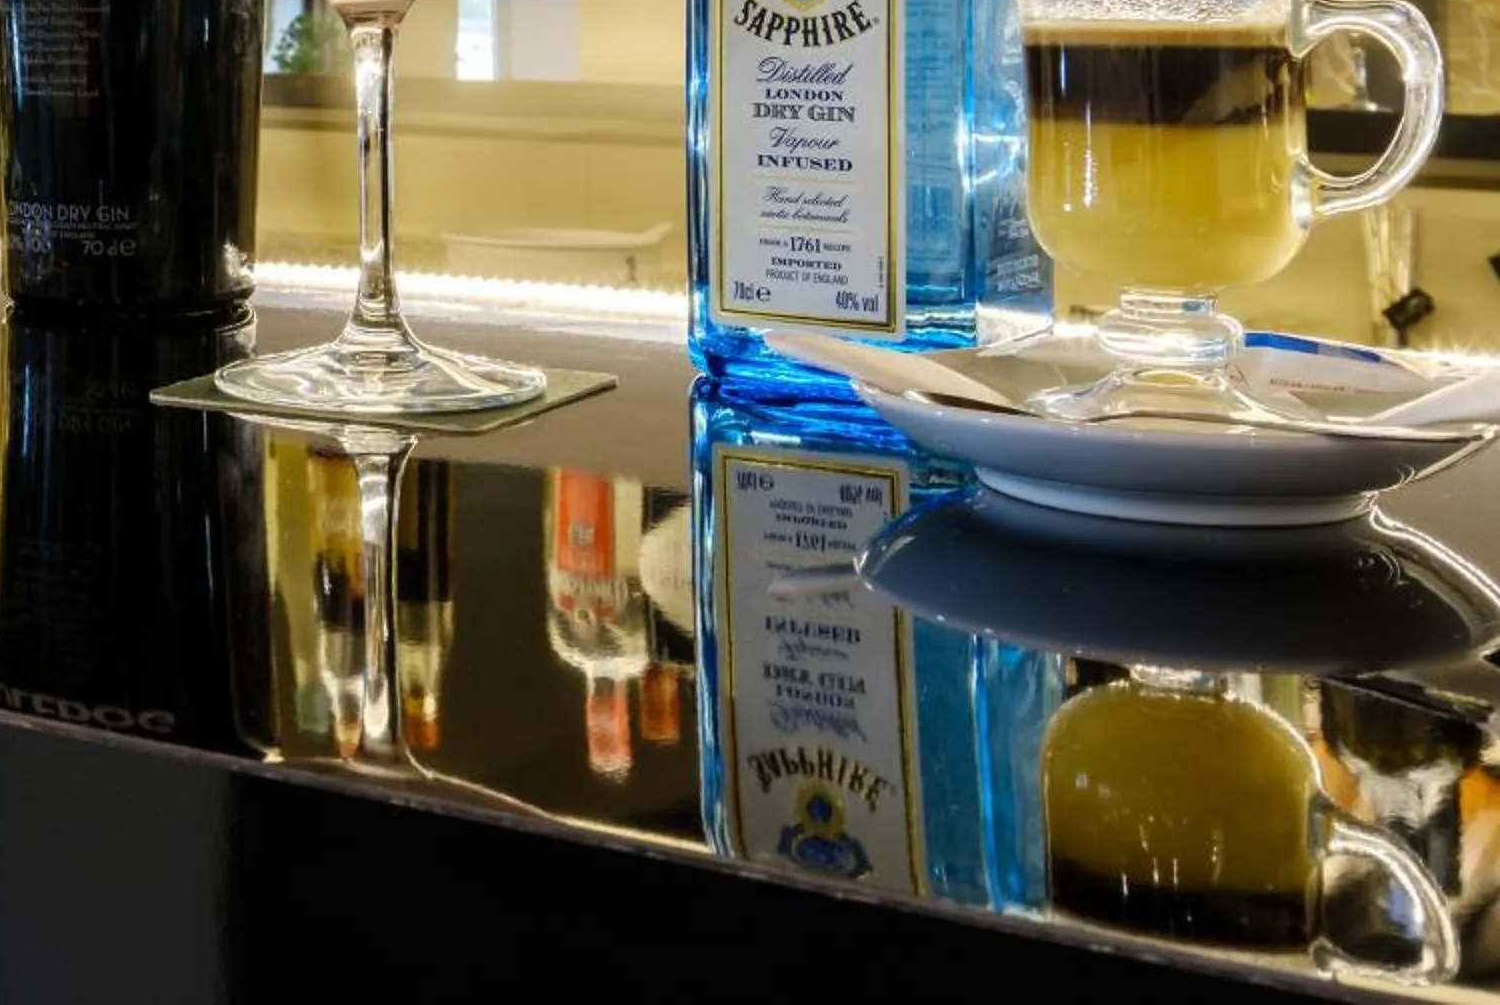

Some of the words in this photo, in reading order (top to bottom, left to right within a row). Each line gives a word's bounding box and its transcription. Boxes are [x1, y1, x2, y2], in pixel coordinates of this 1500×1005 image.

[756, 56, 853, 84] Distilled
[766, 88, 844, 102] LONDON
[752, 102, 803, 120] DRY
[808, 105, 856, 122] GIN
[769, 126, 840, 154] Vapour
[757, 154, 853, 172] INFUSED
[8, 200, 53, 220] ONDON
[57, 203, 91, 221] DRY
[96, 205, 130, 222] GIN
[789, 236, 821, 254] 1761
[771, 256, 843, 271] IMPORTED
[765, 268, 798, 282] PRODUCT
[801, 271, 811, 283] OF
[813, 273, 849, 286] ENGLAND
[835, 290, 860, 311] 40%
[862, 294, 879, 312] vol
